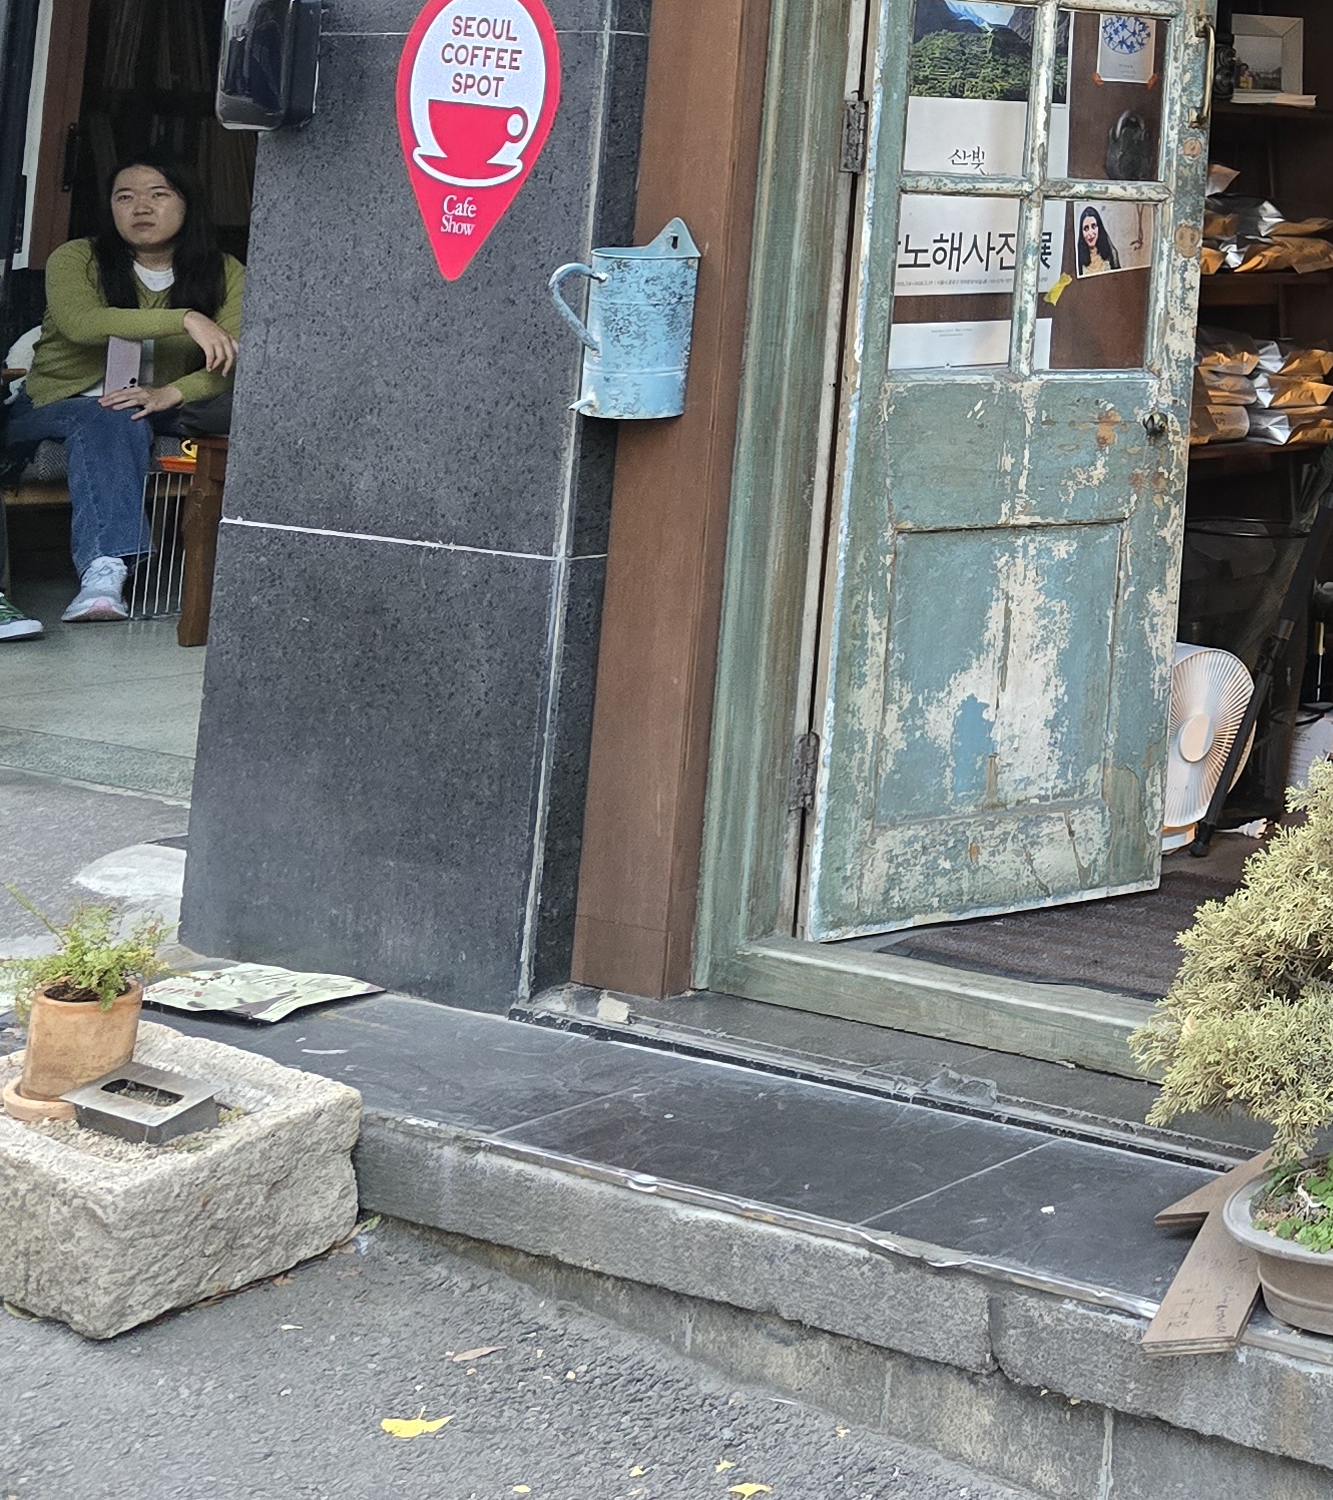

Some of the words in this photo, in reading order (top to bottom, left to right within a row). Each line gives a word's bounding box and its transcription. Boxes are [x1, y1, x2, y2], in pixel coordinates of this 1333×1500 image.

[452, 15, 518, 41] SEOUL
[441, 43, 522, 70] COFFEE
[451, 72, 504, 98] SPOT
[443, 195, 477, 218] Cafe
[440, 214, 475, 236] Show
